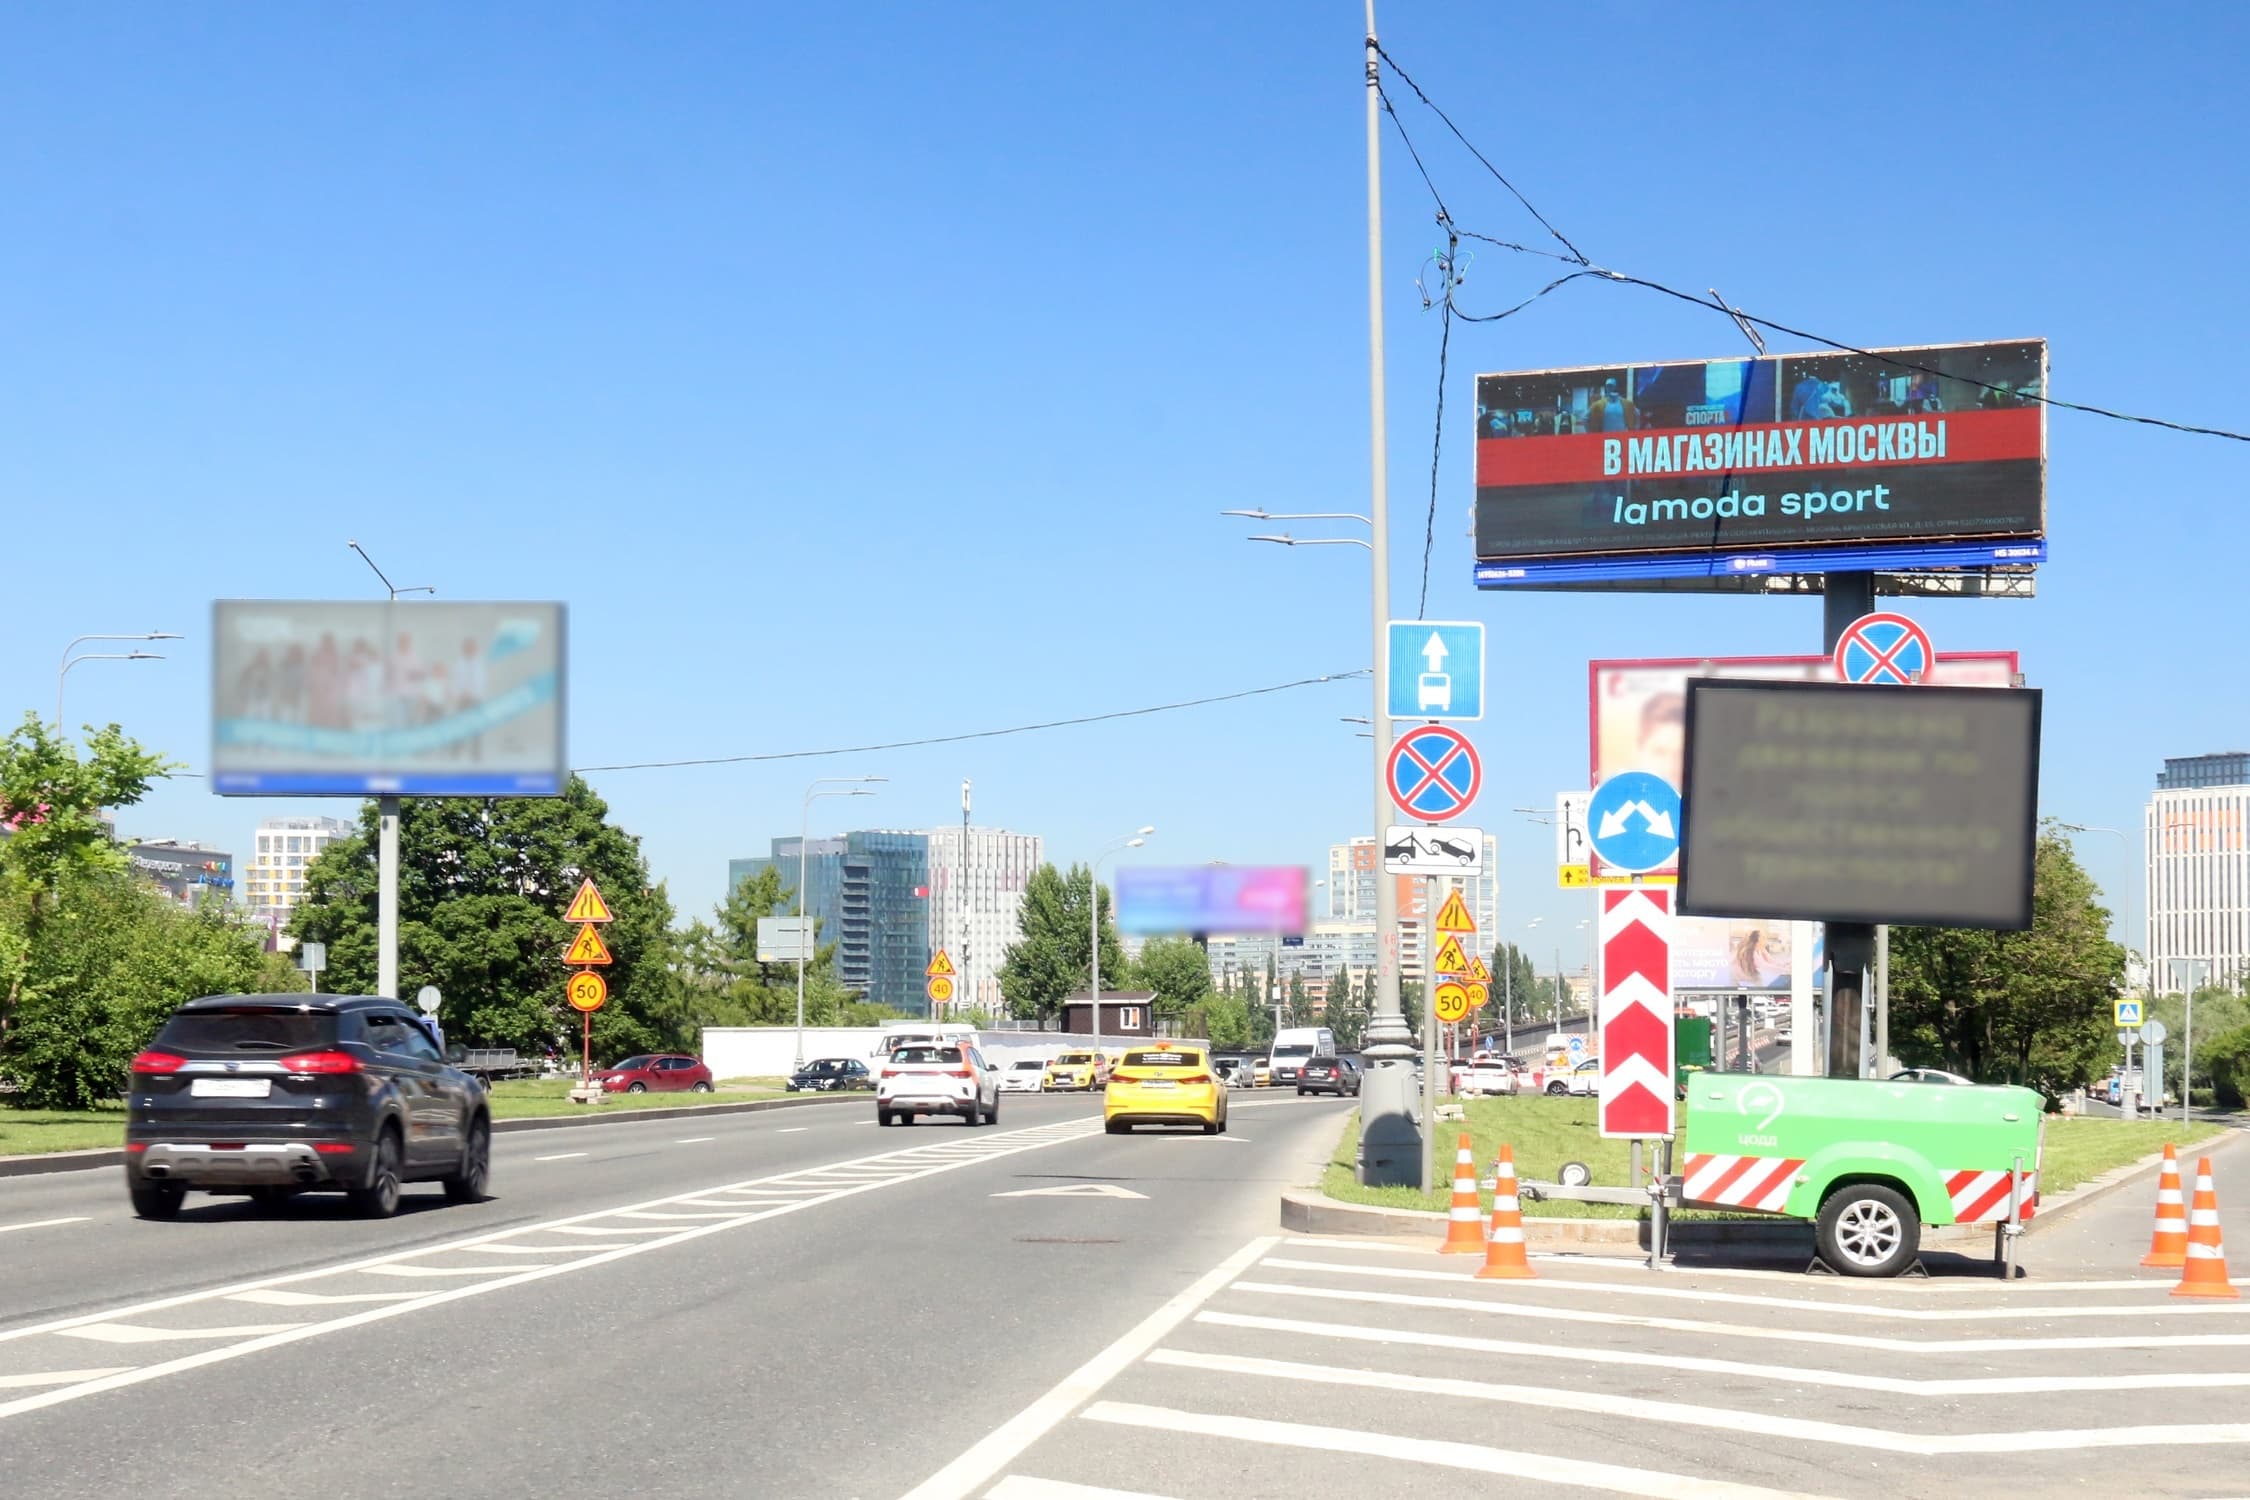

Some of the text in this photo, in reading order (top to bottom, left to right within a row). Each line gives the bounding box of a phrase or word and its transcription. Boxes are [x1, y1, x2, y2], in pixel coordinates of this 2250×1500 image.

[1685, 410, 1726, 425] СПОРТА
[1603, 419, 1947, 475] В МАГАЗИНАХ МОСКВЫ
[1613, 490, 1766, 525] lamoda
[1780, 483, 1891, 519] sport
[577, 984, 597, 999] 50
[933, 984, 948, 993] 40
[1440, 995, 1463, 1012] 50
